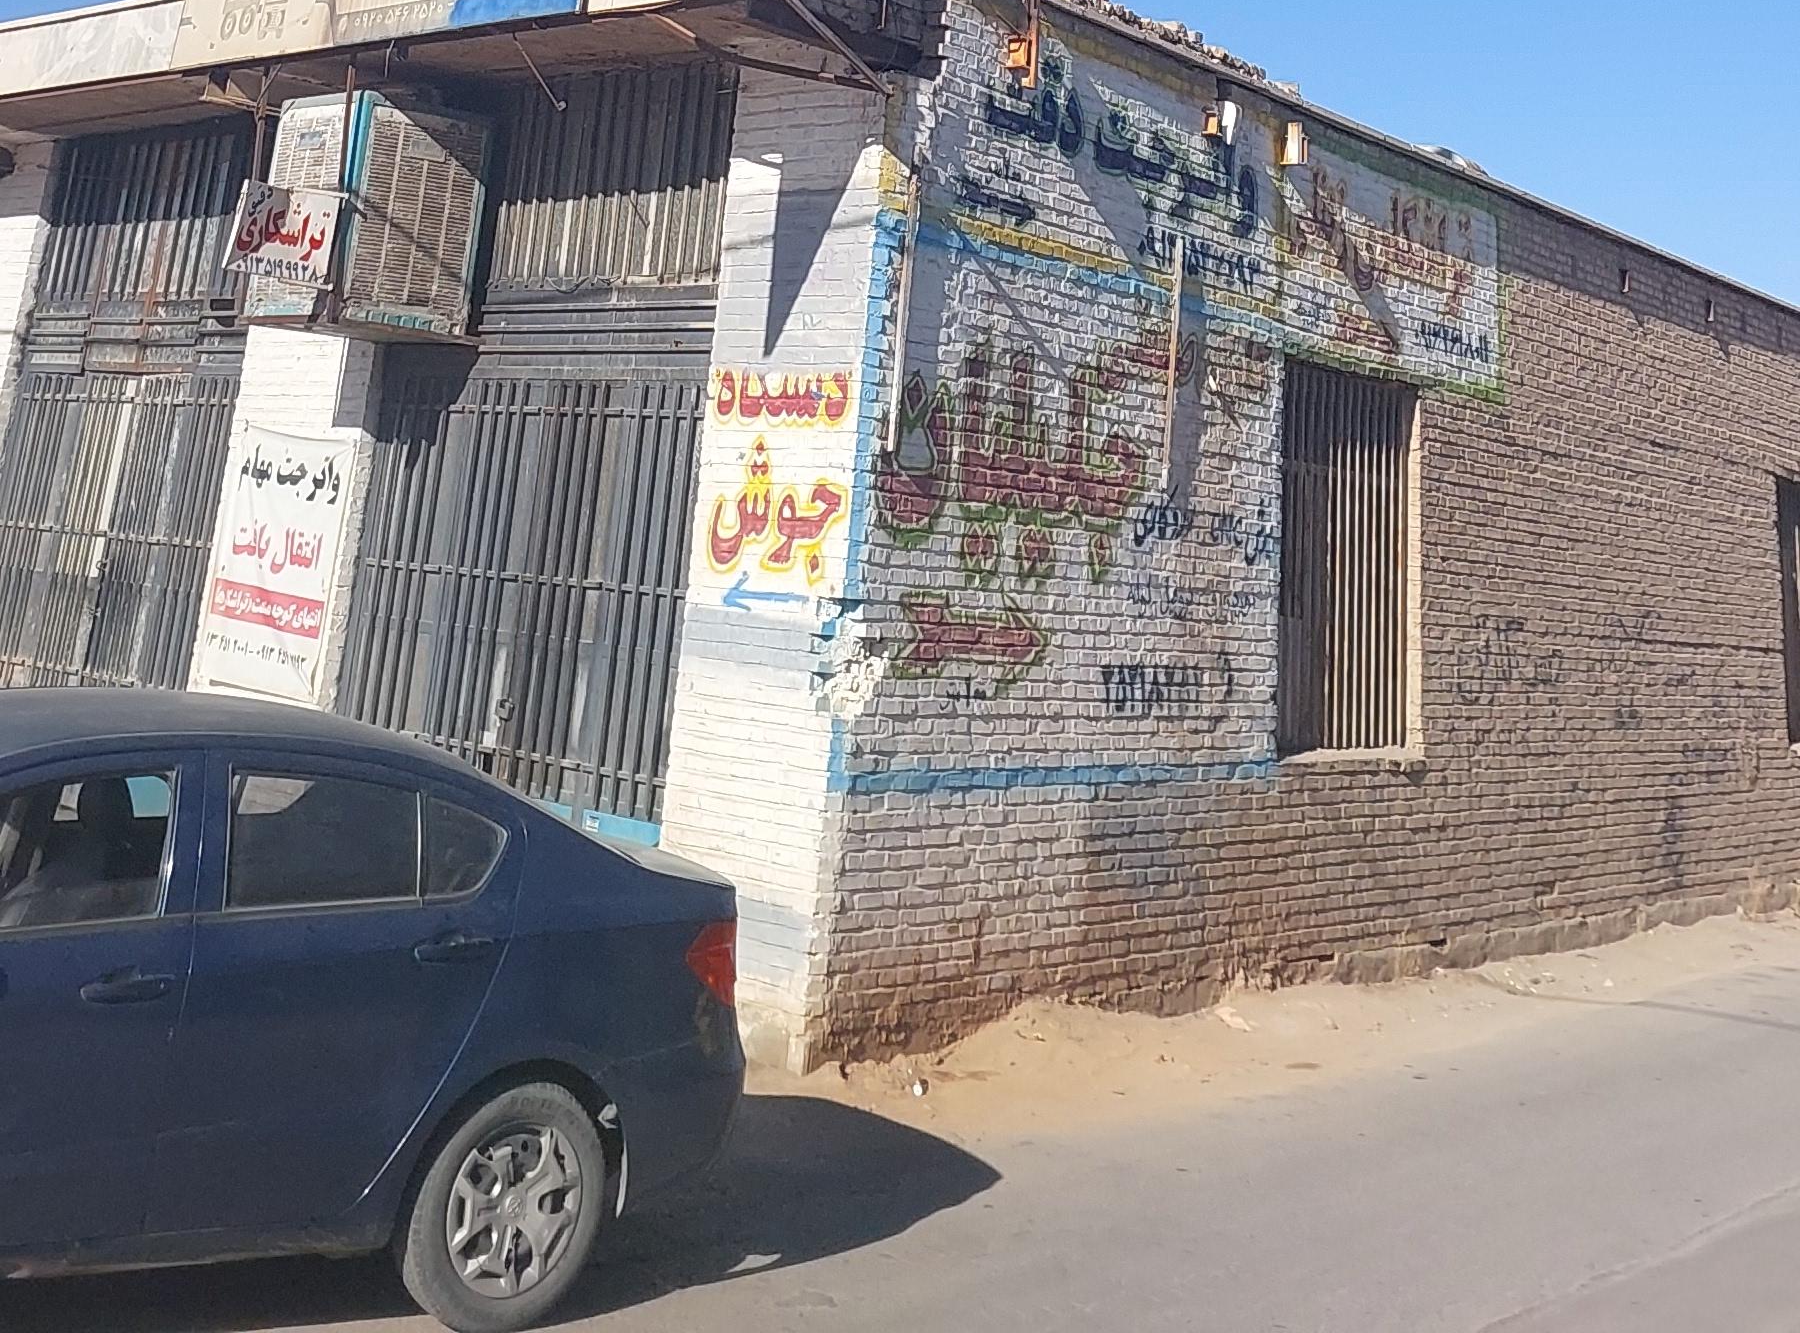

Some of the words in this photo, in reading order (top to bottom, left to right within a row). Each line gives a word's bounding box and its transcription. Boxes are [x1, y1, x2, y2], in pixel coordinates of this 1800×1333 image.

[236, 203, 331, 262] تراشکاری
[709, 437, 845, 577] جوش
[232, 518, 272, 570] یافت
[269, 526, 324, 575] انتقال
[291, 605, 322, 630] انتهای
